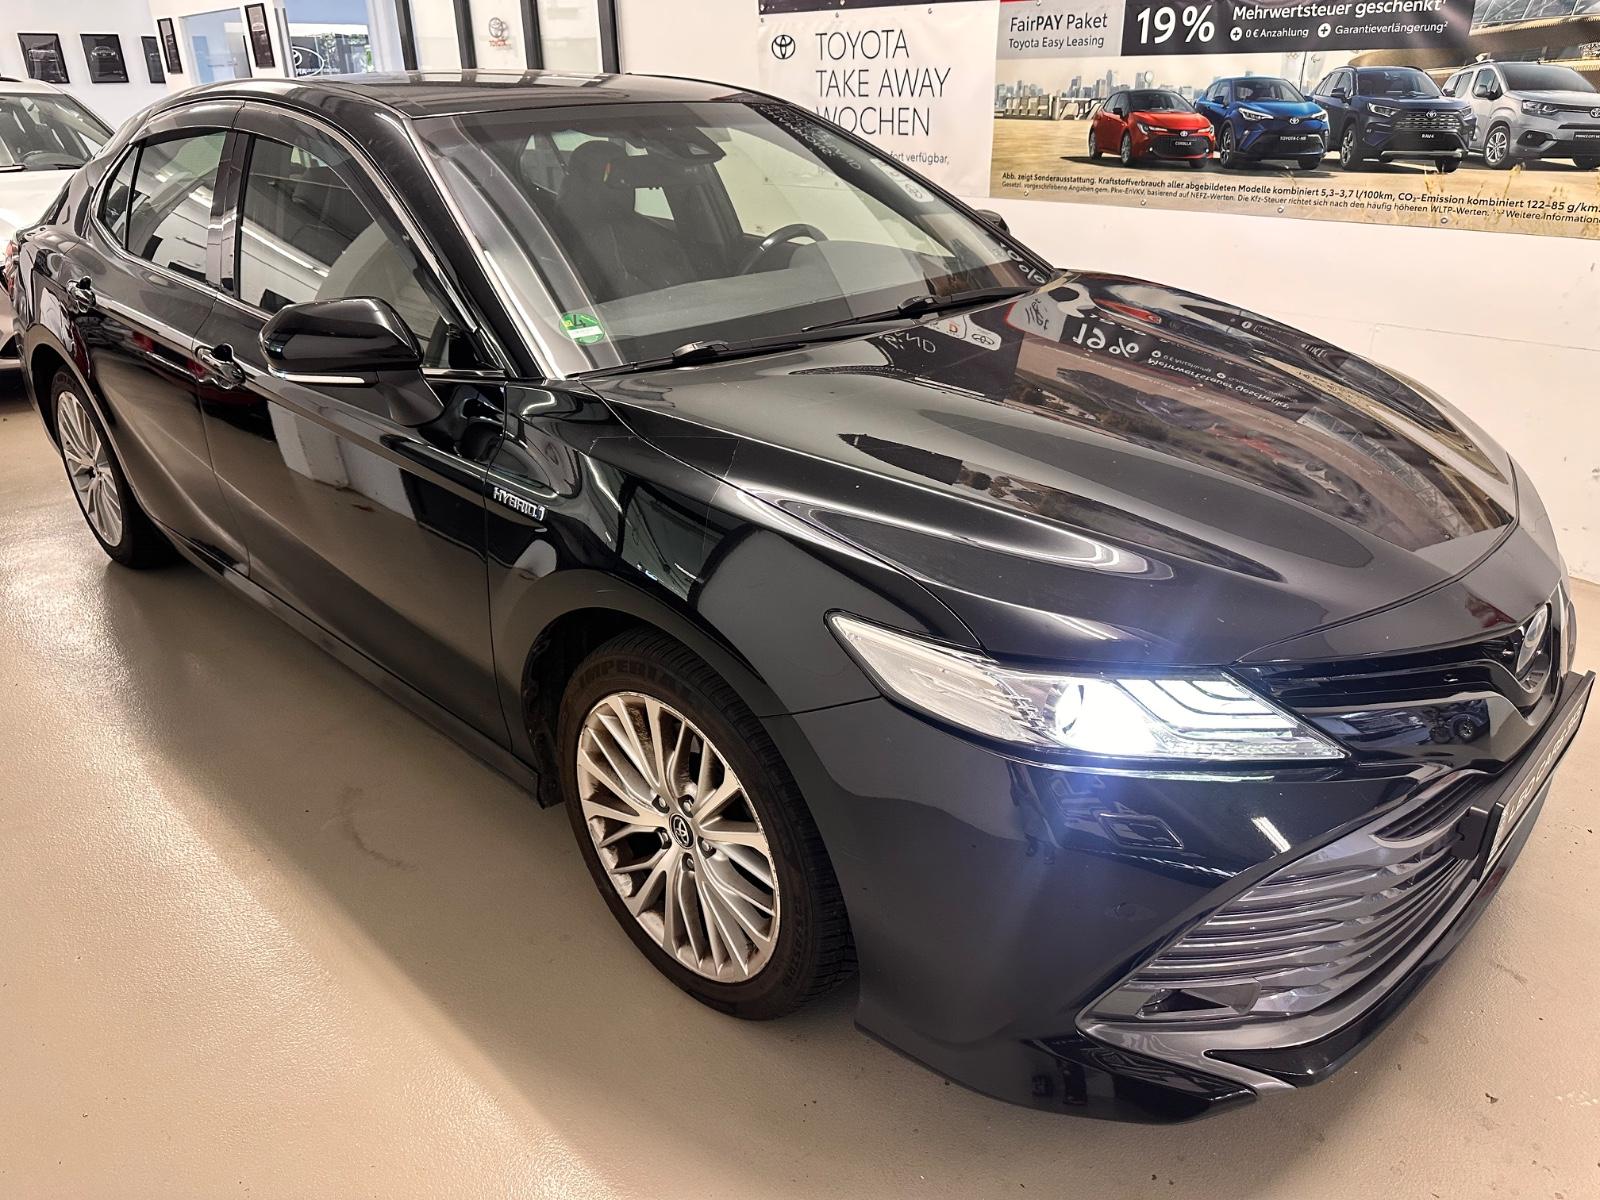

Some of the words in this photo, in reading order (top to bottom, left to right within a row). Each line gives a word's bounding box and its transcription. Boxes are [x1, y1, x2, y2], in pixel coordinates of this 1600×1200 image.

[1010, 14, 1063, 32] FairPAY
[1066, 13, 1108, 30] Paket
[1233, 2, 1350, 20] Mehrwertsteuer
[815, 29, 909, 60] TOYOTA
[1009, 38, 1040, 50] Toyota
[1042, 37, 1064, 50] Easy
[1066, 36, 1105, 48] Leasing
[1260, 28, 1309, 38] Anzahlung
[816, 69, 869, 98] TAKE
[878, 67, 951, 98] AWAY
[906, 152, 950, 166] verfügbar,
[1002, 172, 1016, 180] Abb.
[1018, 174, 1032, 182] zeigt
[1034, 174, 1096, 186] Sonderausstattung.
[1098, 178, 1166, 188] Kraftstoffverbrauch
[1167, 180, 1184, 188] aller
[1186, 182, 1236, 192] abgebildeten
[1238, 184, 1271, 194] Modelle
[1272, 186, 1318, 196] kombiniert
[1356, 190, 1396, 201] l/100km,
[1467, 196, 1524, 208] kombiniert
[1024, 183, 1067, 191] vorgeschriebene
[1068, 185, 1094, 193] Angaben
[1147, 189, 1177, 198] basierend
[1179, 190, 1189, 198] auf
[1190, 191, 1234, 200] NEFZ-Werten.
[1238, 194, 1248, 202] Die
[1250, 195, 1287, 204] Kfz-Steuer
[1288, 197, 1312, 205] richtet
[1329, 200, 1348, 208] nach
[1350, 200, 1364, 209] den
[1367, 202, 1392, 211] häufig
[1394, 204, 1427, 212] höheren
[1506, 210, 1541, 220] Weitere
[493, 487, 546, 521] HYBRID
